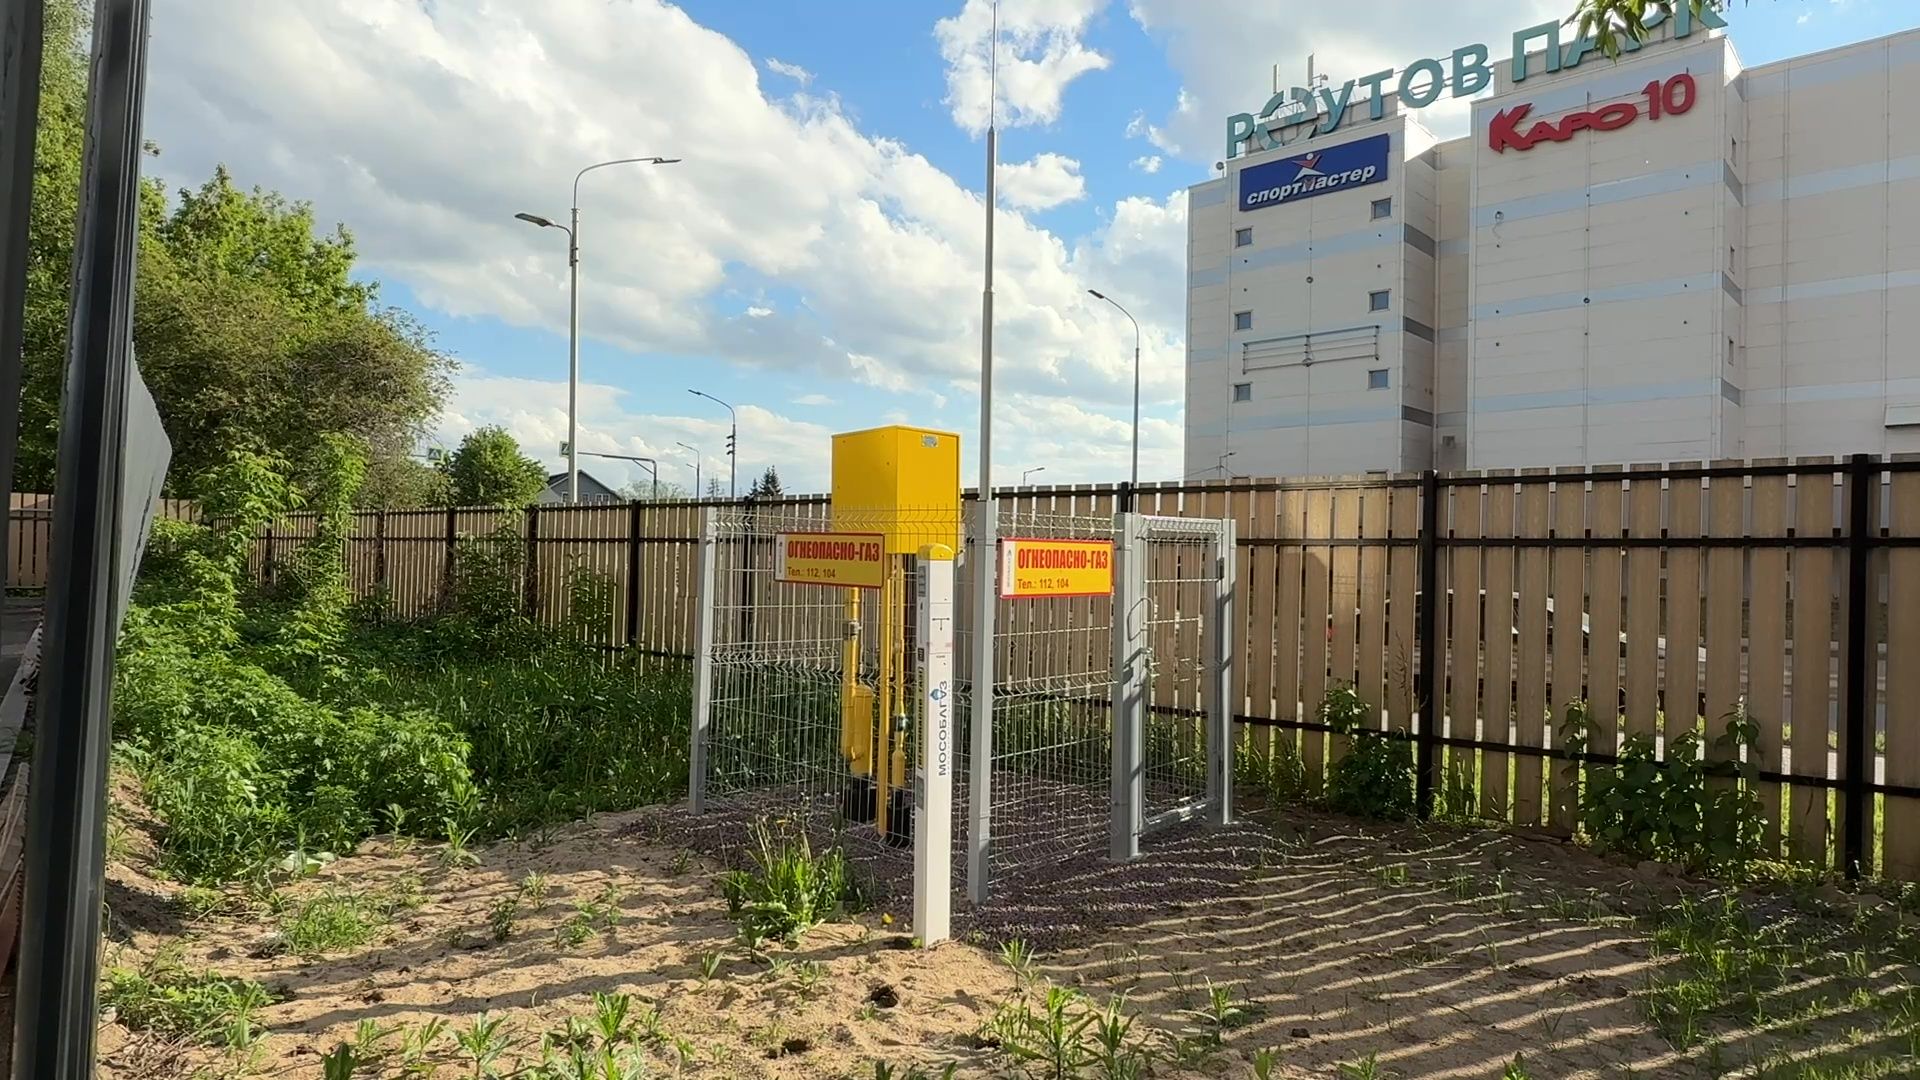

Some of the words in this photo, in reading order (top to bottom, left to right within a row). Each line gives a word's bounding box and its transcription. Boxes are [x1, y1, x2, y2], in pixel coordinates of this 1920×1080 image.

[1641, 73, 1696, 120] 10
[788, 541, 879, 561] ОГНЕОПАСНО-ГАЗ
[1018, 548, 1108, 569] ОГНЕОПАСНО-ГАЗ
[823, 569, 836, 578] 104
[1056, 578, 1069, 588] 104
